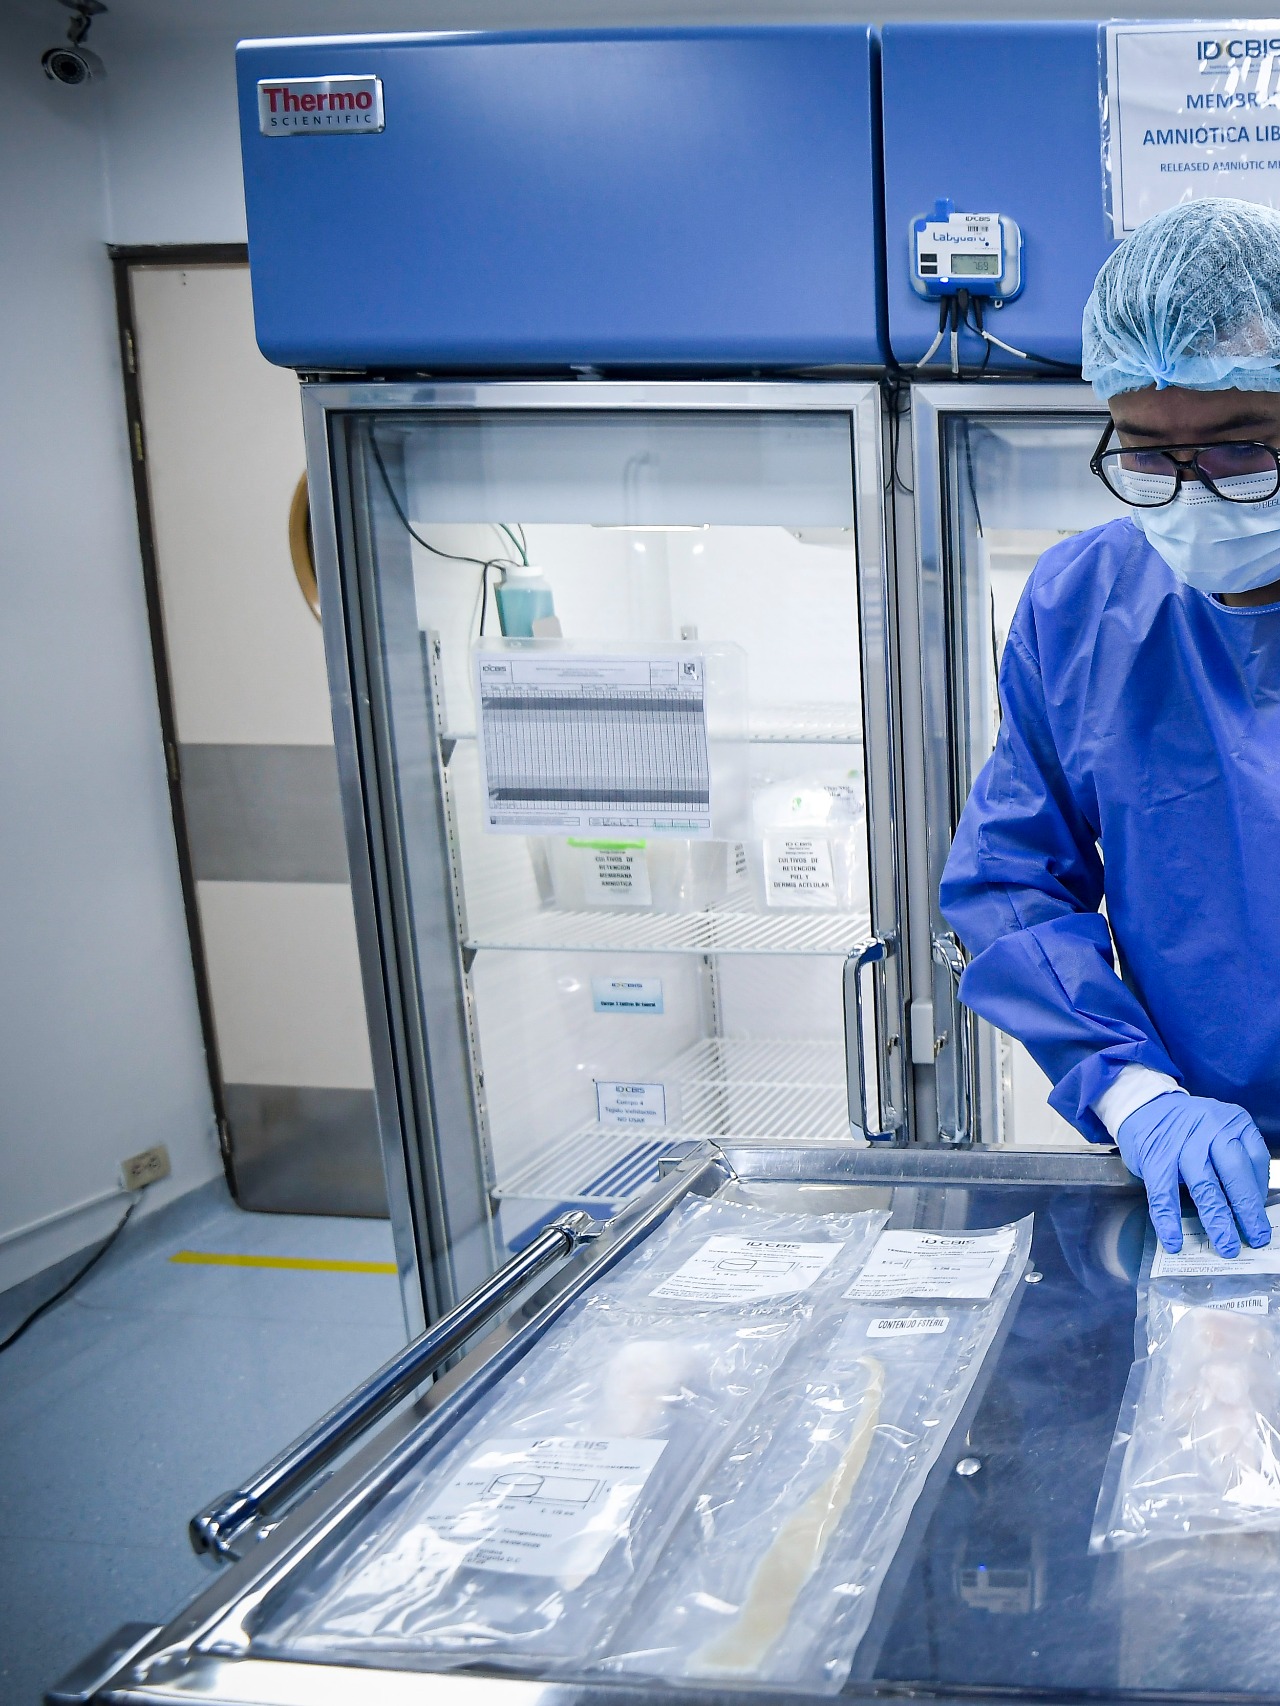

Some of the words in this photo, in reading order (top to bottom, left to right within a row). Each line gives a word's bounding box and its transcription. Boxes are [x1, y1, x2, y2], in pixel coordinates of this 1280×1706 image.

[263, 88, 373, 112] Thermo
[271, 114, 372, 127] SCIENTIFIC
[1160, 161, 1210, 173] RELEASED
[1212, 160, 1265, 172] AMNIOTIC
